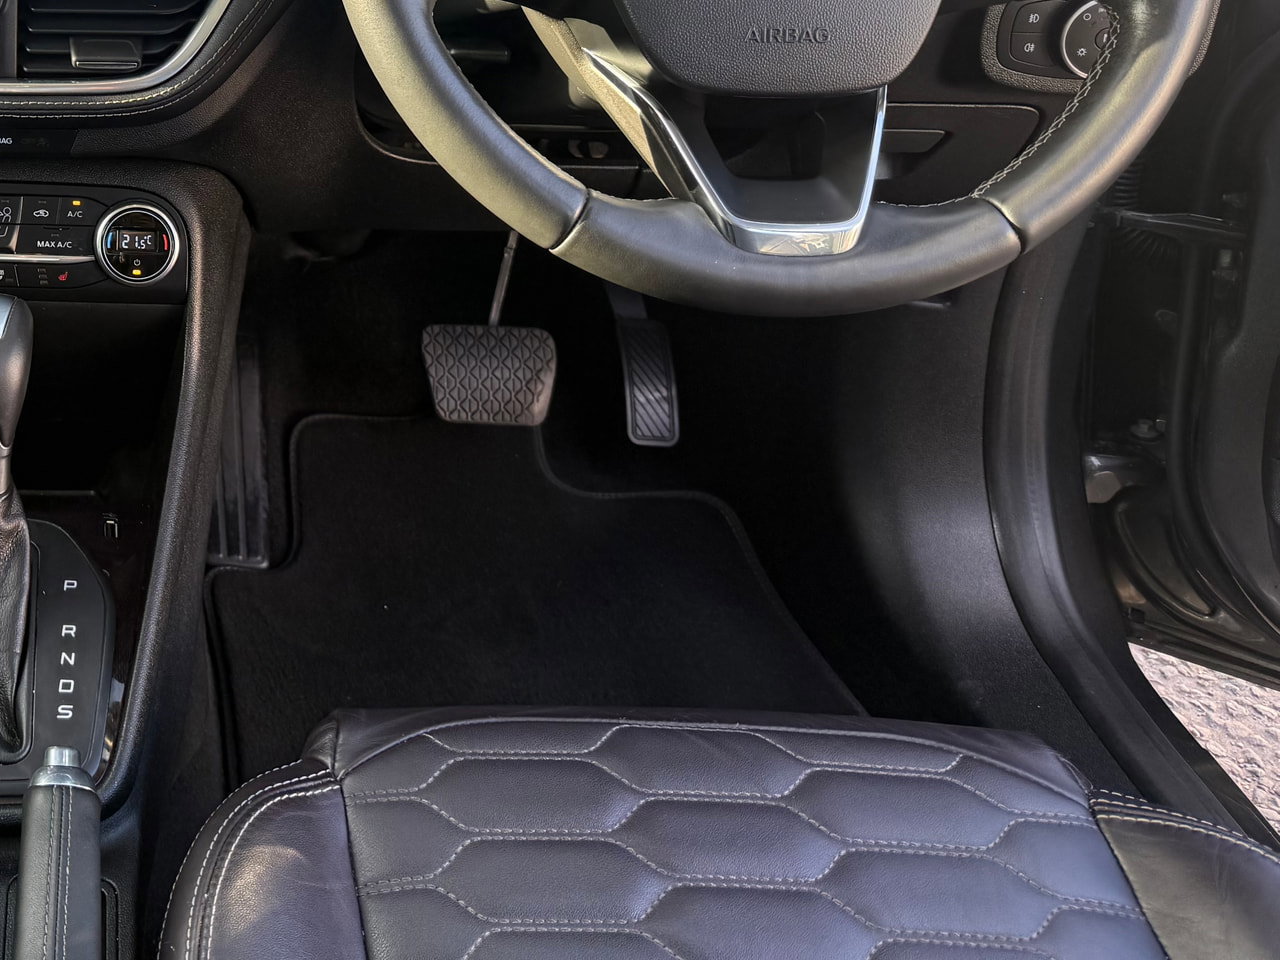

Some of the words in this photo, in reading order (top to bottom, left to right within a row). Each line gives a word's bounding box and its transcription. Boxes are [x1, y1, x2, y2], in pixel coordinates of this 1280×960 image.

[743, 26, 832, 44] AIRBAG
[67, 210, 83, 218] A/C
[36, 240, 55, 248] MAX
[57, 240, 72, 249] A/C
[63, 579, 77, 591] P
[61, 624, 76, 638] R
[60, 652, 75, 666] N
[58, 679, 74, 693] D
[56, 704, 73, 719] S
